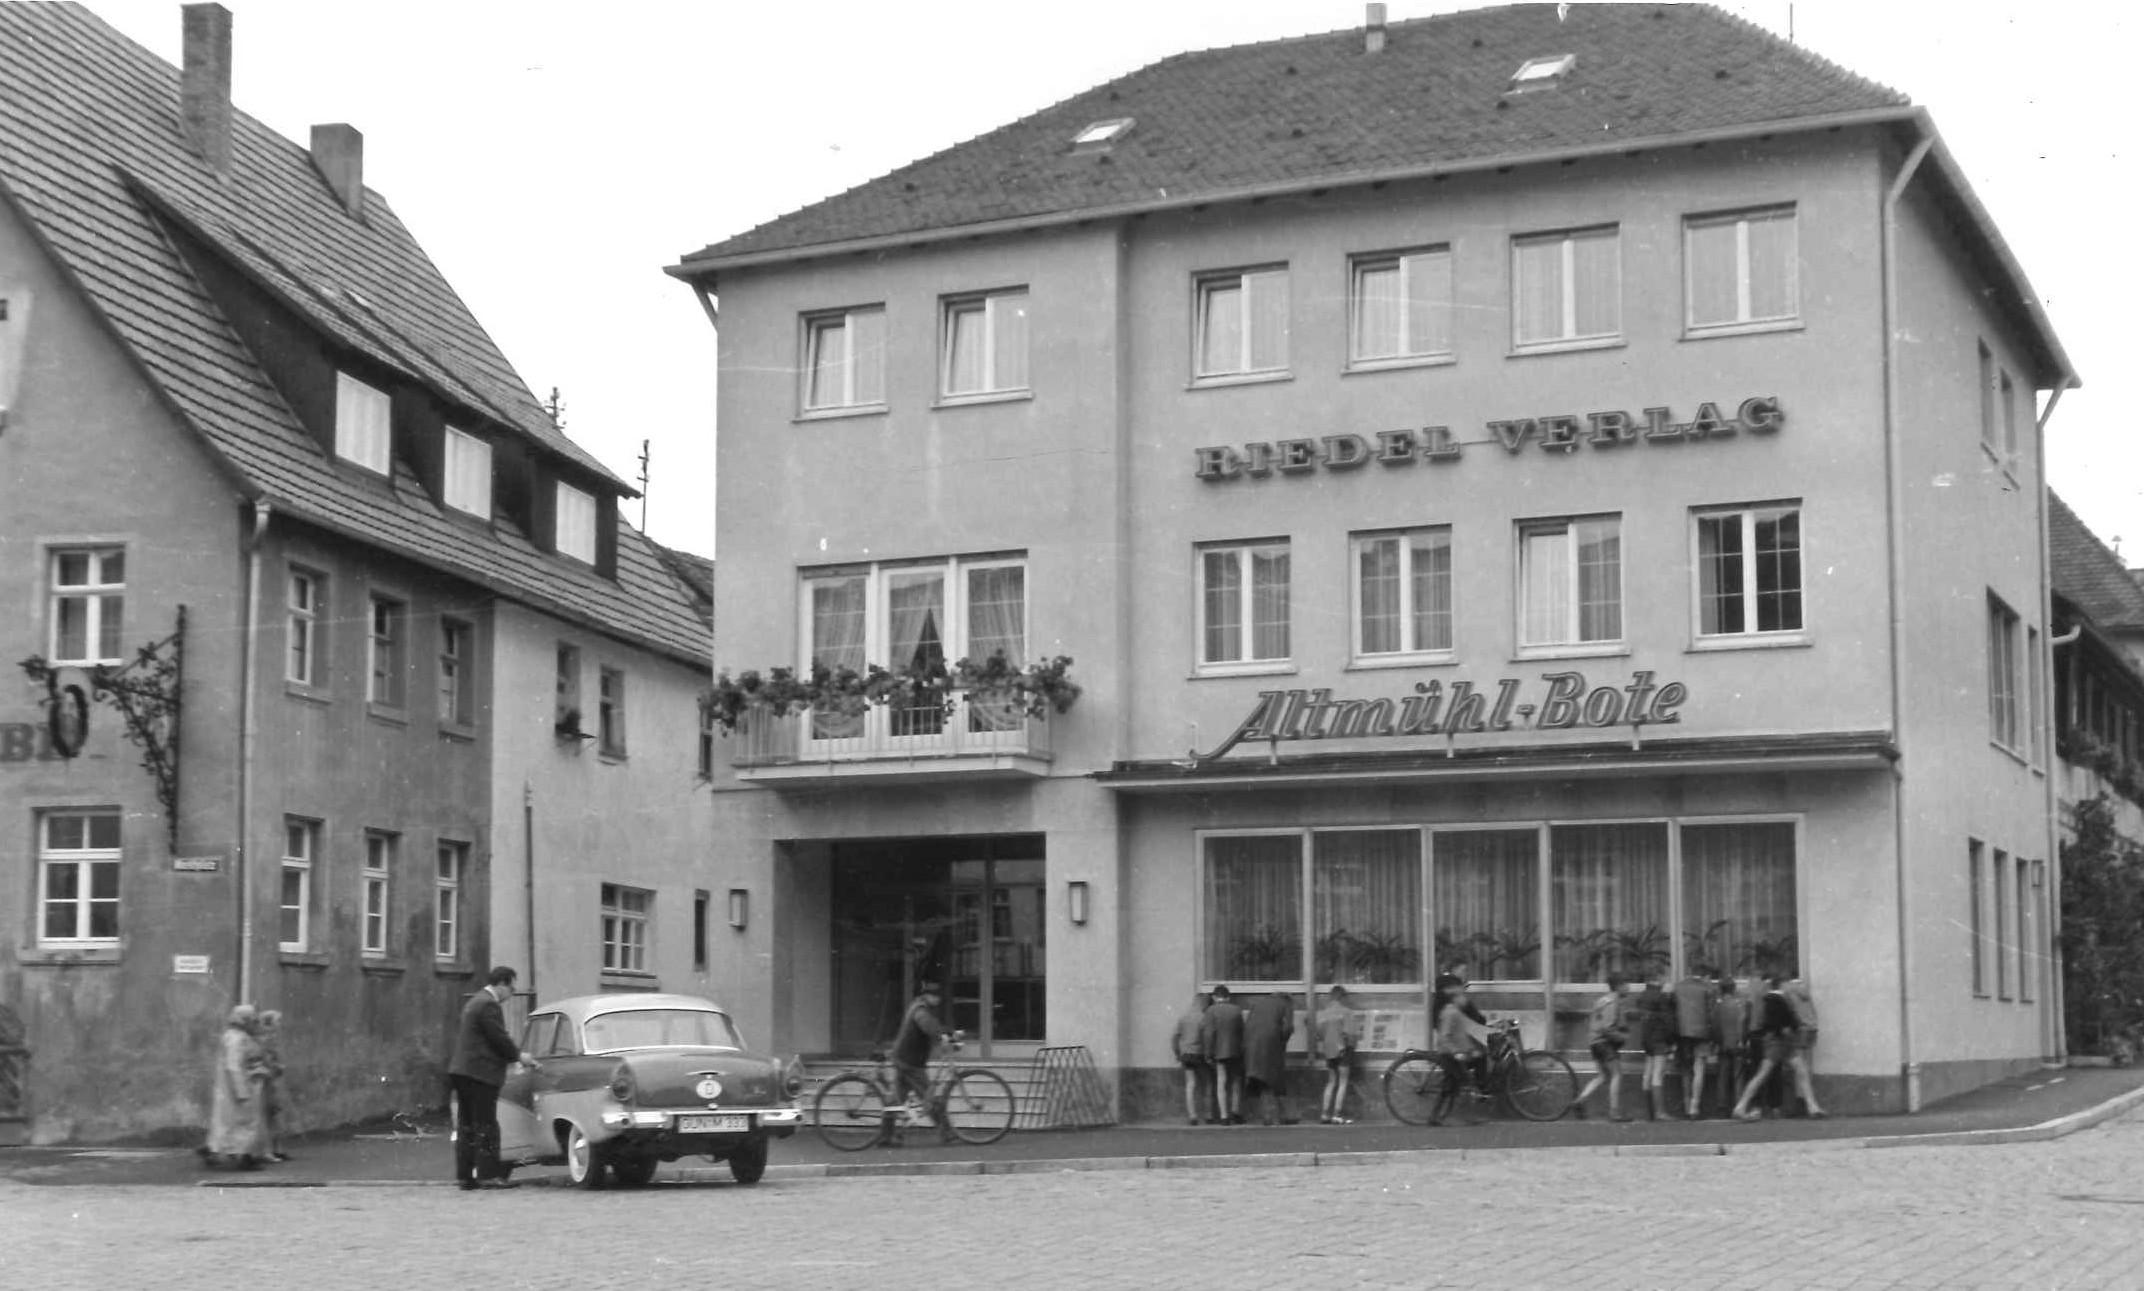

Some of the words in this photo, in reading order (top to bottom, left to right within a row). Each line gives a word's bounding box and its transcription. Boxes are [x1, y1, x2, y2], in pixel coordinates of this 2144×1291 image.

[1195, 424, 1461, 482] RIEDEL
[1486, 396, 1785, 455] VERLAG
[1189, 671, 1688, 760] Altmühl-Bote
